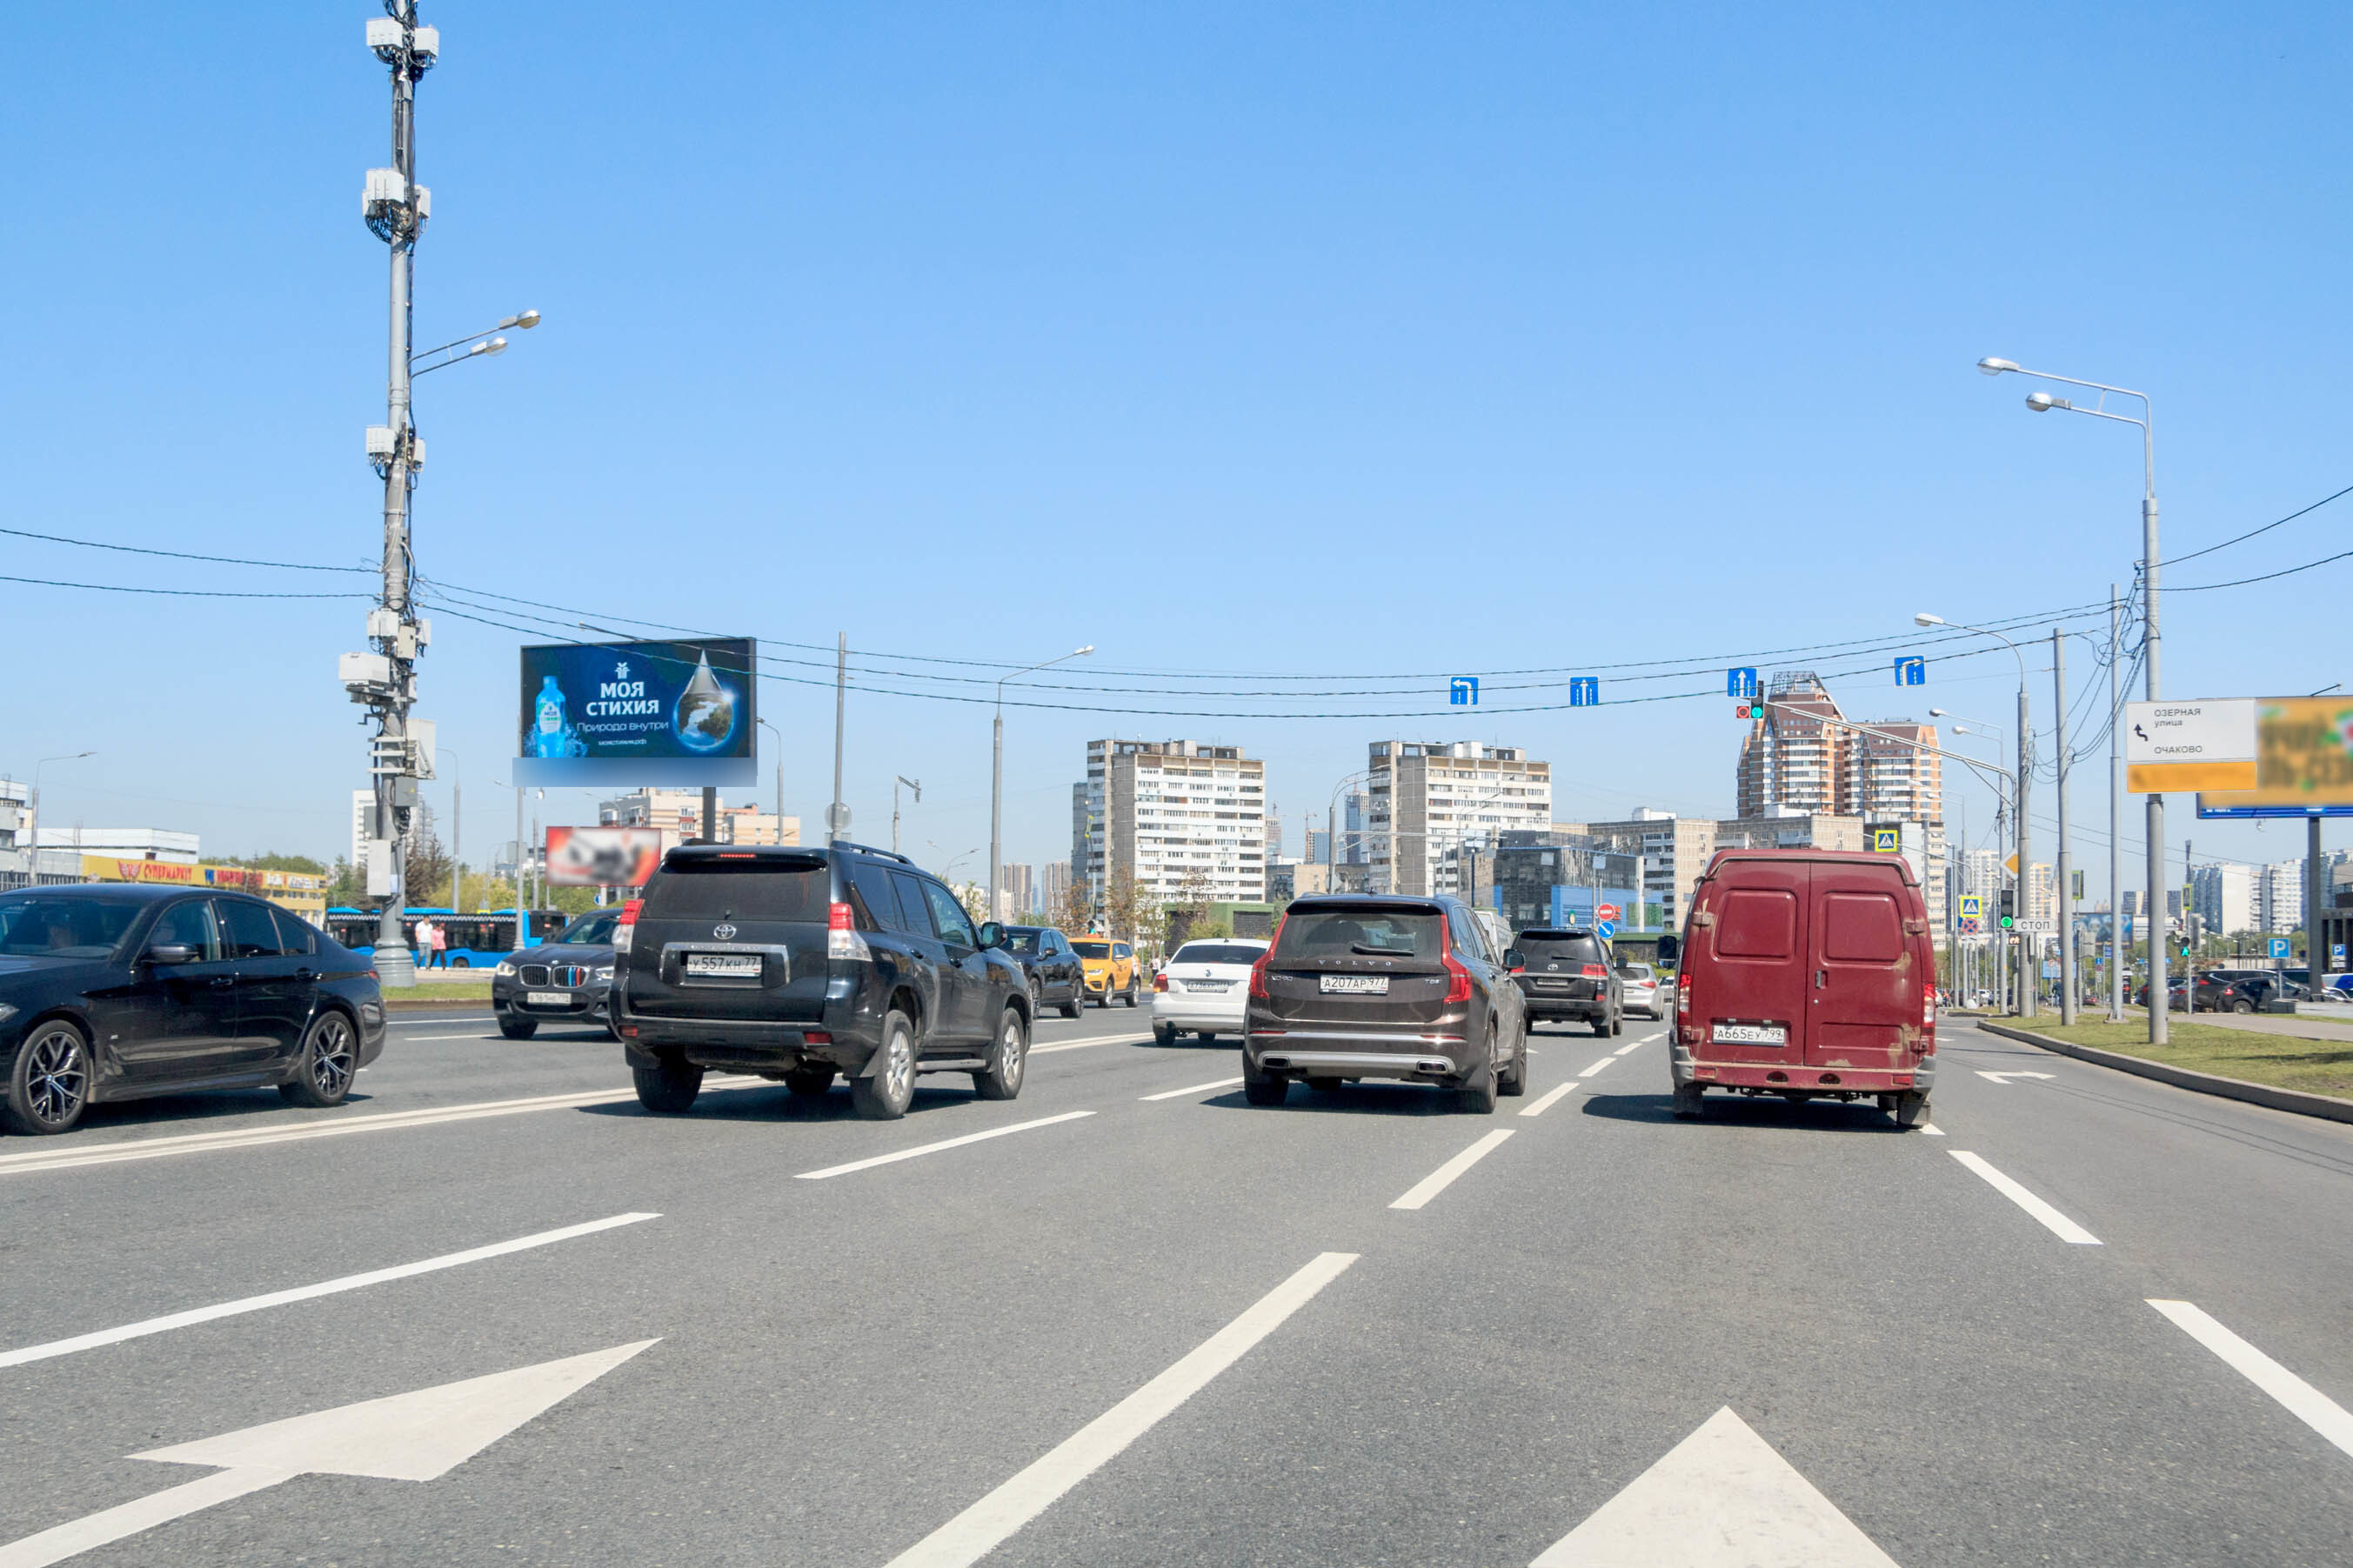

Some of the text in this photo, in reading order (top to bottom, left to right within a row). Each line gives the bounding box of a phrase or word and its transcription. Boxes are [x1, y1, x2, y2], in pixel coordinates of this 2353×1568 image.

[600, 682, 645, 698] МОЯ
[585, 699, 659, 716] СТИХИЯ
[2154, 708, 2201, 717] ОЗЕРНАЯ
[577, 721, 669, 733] Природа внутри
[2154, 719, 2183, 728] улица
[2154, 745, 2203, 755] ОЧАКОВО
[2021, 921, 2050, 930] СТОП
[2274, 940, 2286, 956] P
[2334, 945, 2343, 955] P
[745, 957, 758, 966] 77
[1324, 976, 1386, 989] А207АР 977
